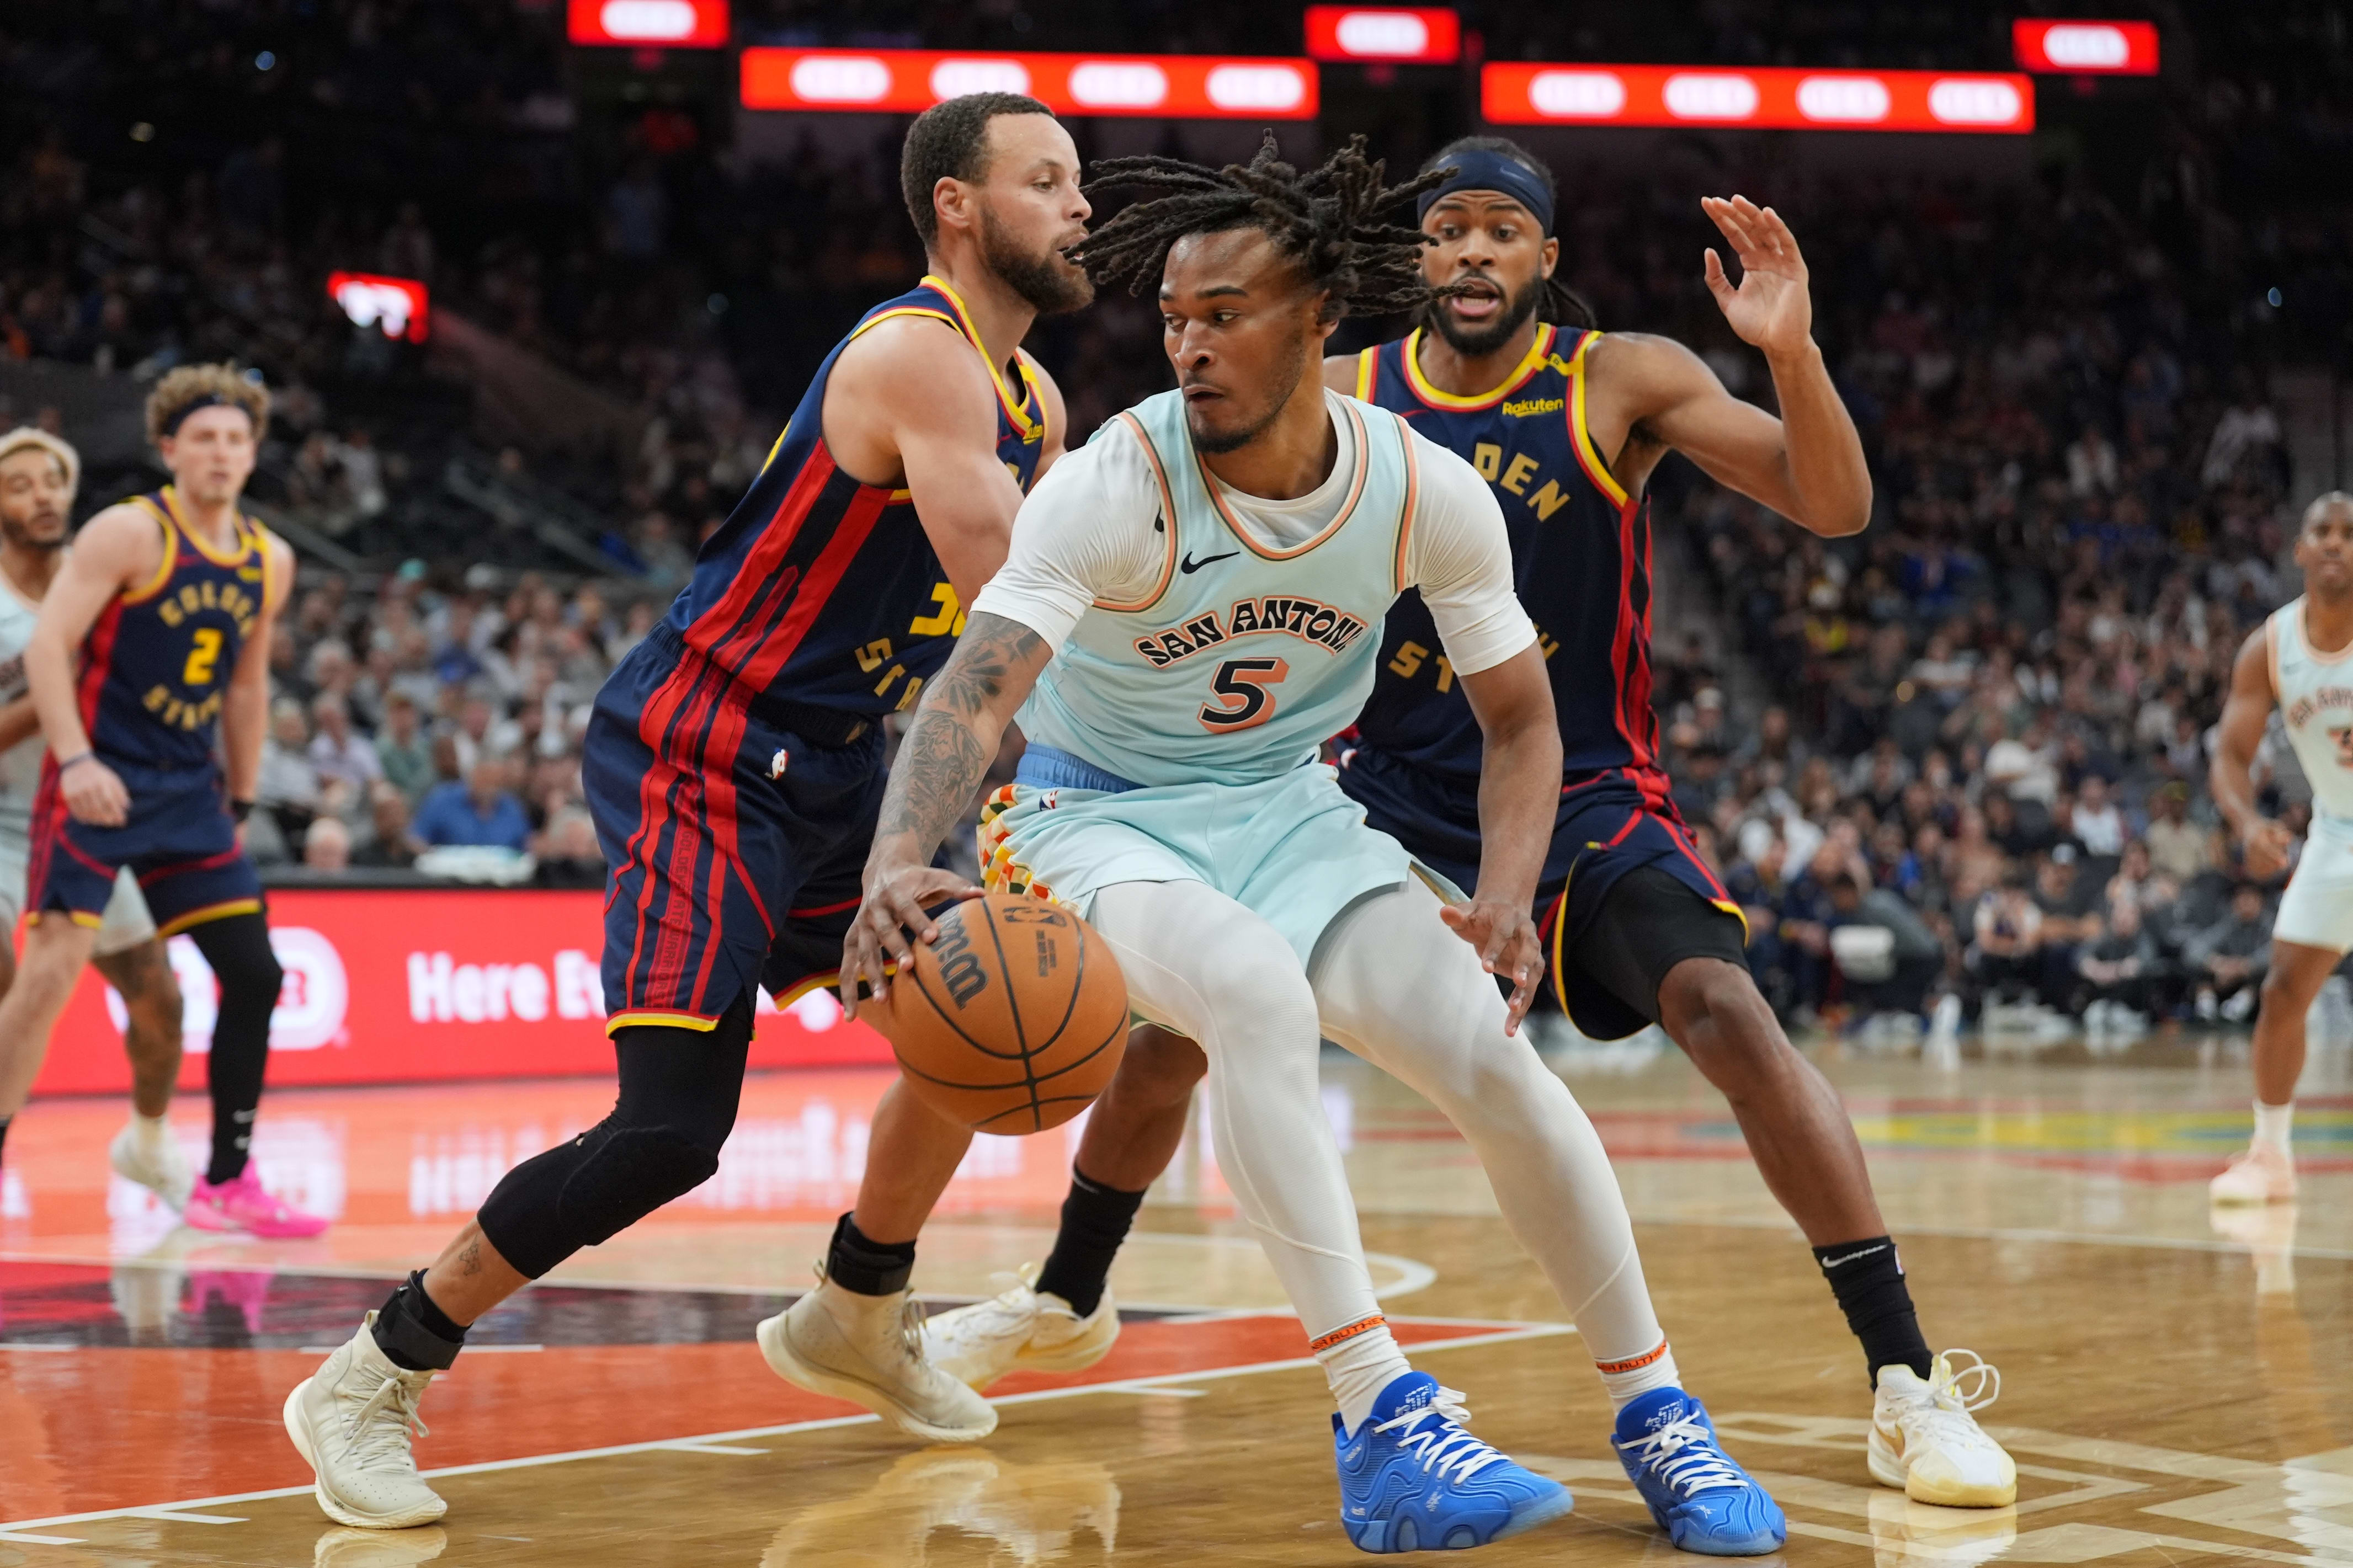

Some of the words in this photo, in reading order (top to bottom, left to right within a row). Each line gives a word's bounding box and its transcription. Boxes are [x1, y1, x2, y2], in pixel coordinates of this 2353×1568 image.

[1502, 398, 1564, 418] Rakuten
[1472, 442, 1571, 522] DEN
[909, 582, 966, 637] 3
[1135, 611, 1229, 669] SAN
[1227, 596, 1367, 655] ANTONI
[184, 627, 223, 686] 2
[855, 637, 923, 711] STA
[1197, 657, 1289, 734] 5
[407, 951, 549, 1024] Here
